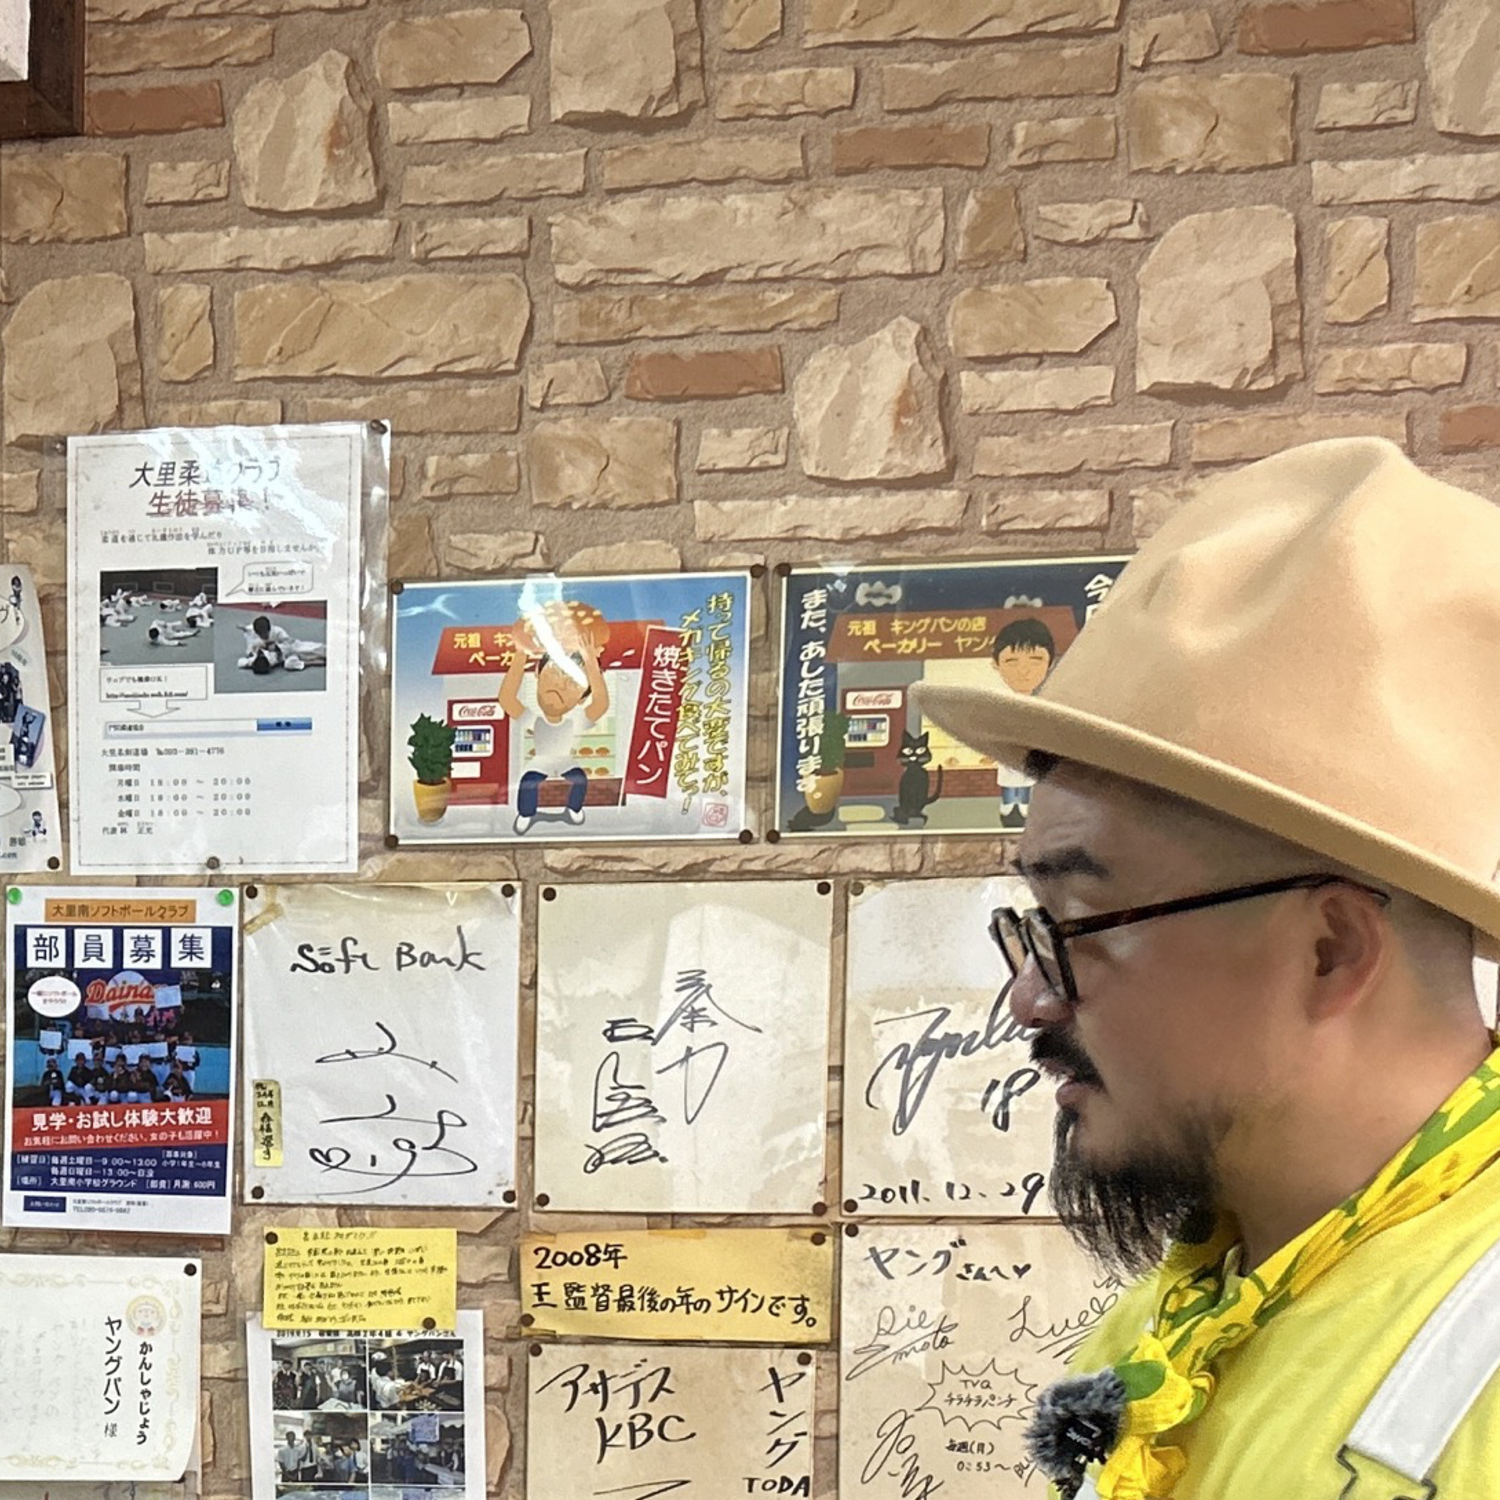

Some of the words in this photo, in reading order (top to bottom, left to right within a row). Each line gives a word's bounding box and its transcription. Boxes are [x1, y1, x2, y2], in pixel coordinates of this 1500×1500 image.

[847, 620, 876, 636] 元祖
[889, 617, 986, 635] キングパンの店
[453, 632, 481, 649] 元祖
[863, 637, 942, 654] ベーカリー
[635, 644, 680, 785] 焼きたてパン
[52, 904, 189, 919] 大里南ソフトボールクラブ
[33, 934, 205, 963] 部員募集
[397, 926, 485, 971] Bank
[32, 1107, 212, 1131] 見学・お試し体験大歓迎
[534, 1243, 628, 1269] 2008年
[531, 1282, 817, 1328] 王監督最後の年のサインです。
[103, 1316, 123, 1415] ヤングパン
[137, 1342, 154, 1445] かんしゃじょう
[104, 1422, 117, 1437] 様
[596, 1414, 697, 1464] KBC
[742, 1477, 810, 1497] TODA
